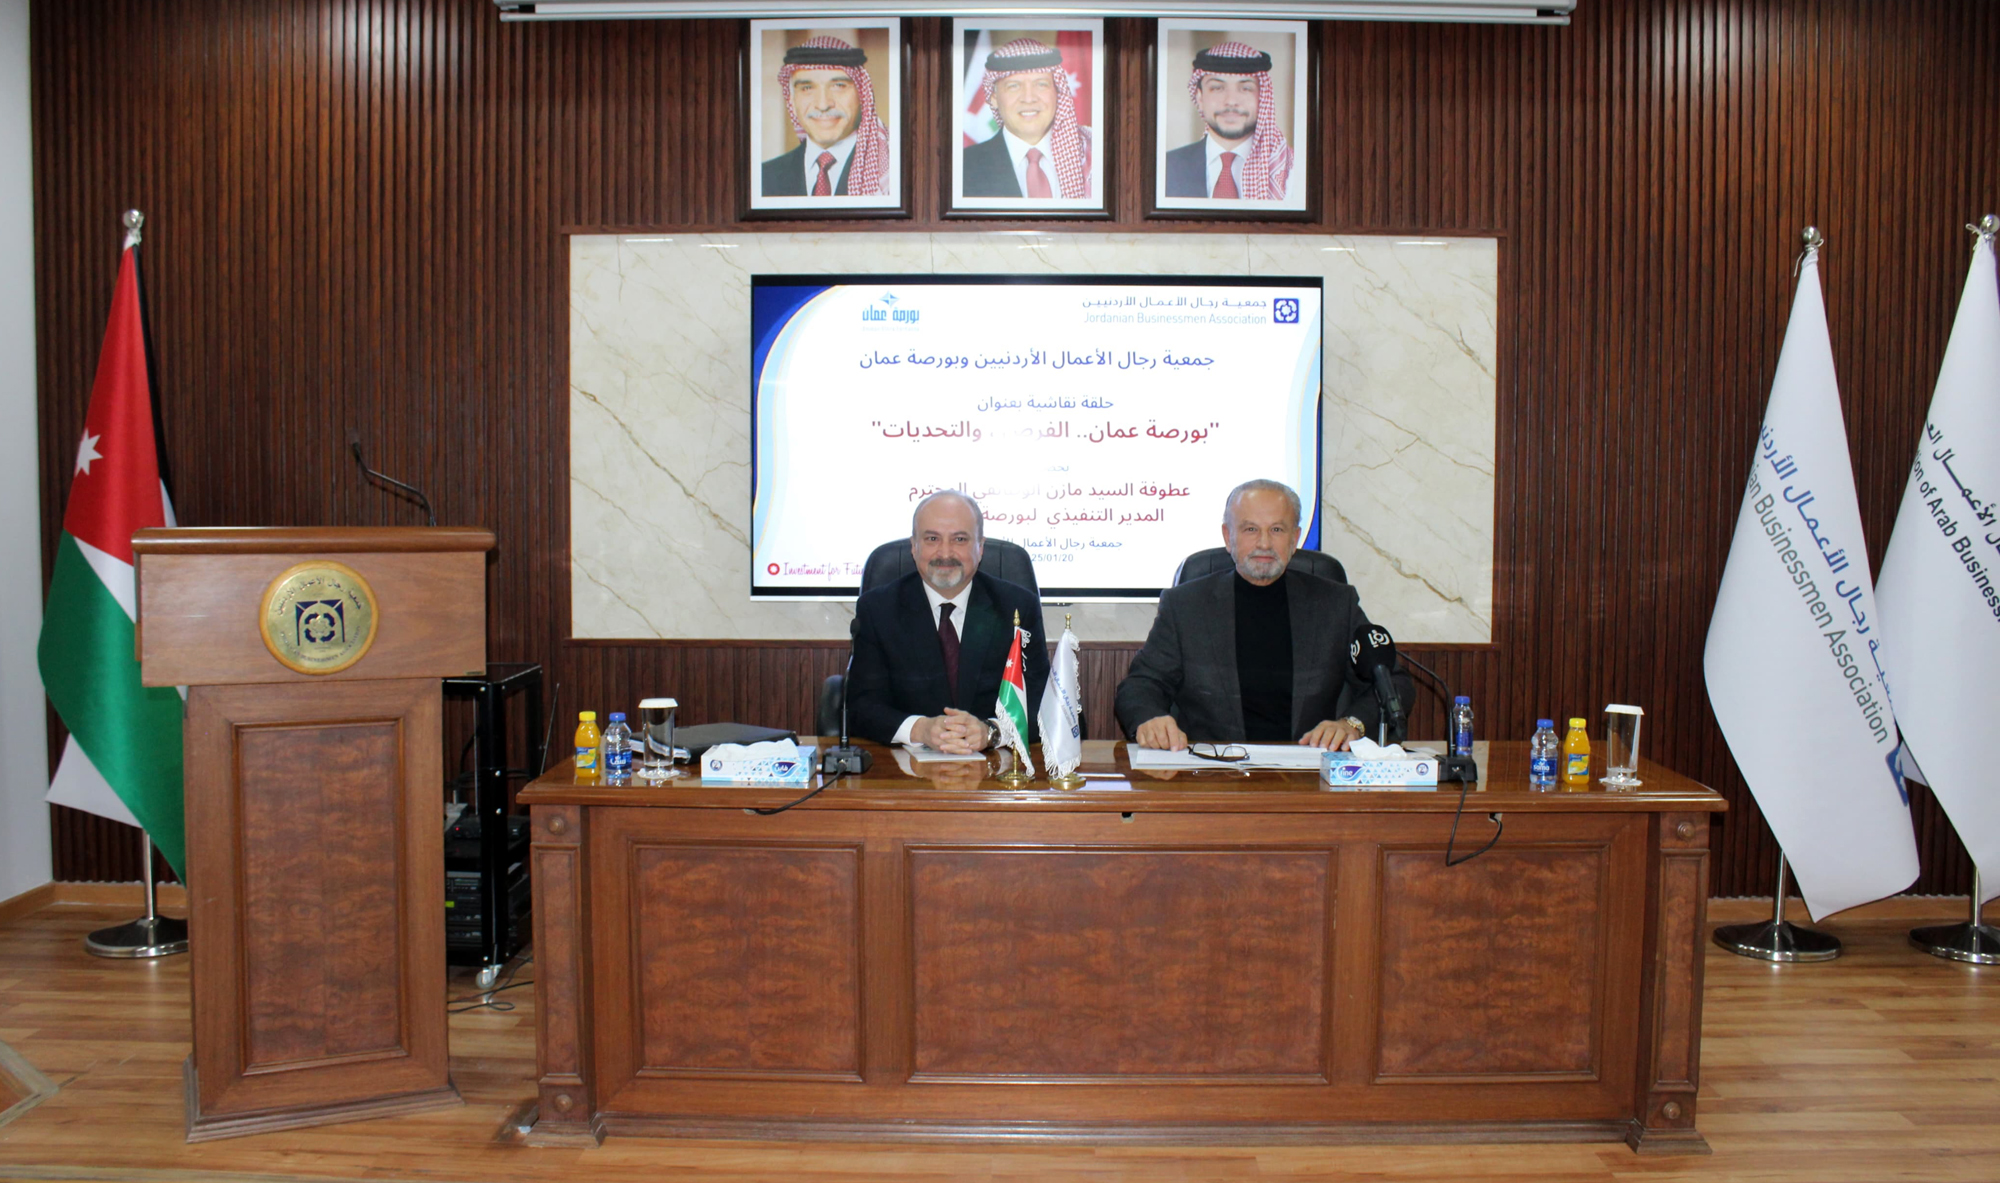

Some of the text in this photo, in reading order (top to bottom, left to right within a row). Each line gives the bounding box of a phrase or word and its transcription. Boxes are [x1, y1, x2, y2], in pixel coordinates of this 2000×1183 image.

[1082, 295, 1267, 309] جمعية رجال الأعمال الأردنيين
[1084, 312, 1267, 325] Jordanian Businessmen Association
[860, 348, 1215, 370] جمعية رجال الأعمال الأردنيين وبورصة عمان
[977, 395, 1115, 412] حلقة نقاشية بعنوان
[1046, 482, 1083, 502] مازن
[1088, 482, 1134, 502] السيد
[1139, 481, 1191, 501] عطوفة
[1919, 480, 1937, 499] of
[1047, 508, 1113, 530] التنفيذي
[1118, 508, 1165, 525] المدير
[1926, 497, 1958, 538] Arab
[1783, 485, 1850, 574] الأعمال
[1059, 538, 1086, 551] رجال
[1088, 537, 1123, 550] جمعية
[1031, 553, 1074, 563] 25/01/20
[1951, 535, 2000, 622] Business
[1835, 578, 1870, 635] رجال
[1754, 493, 1888, 745] Businessmen Association
